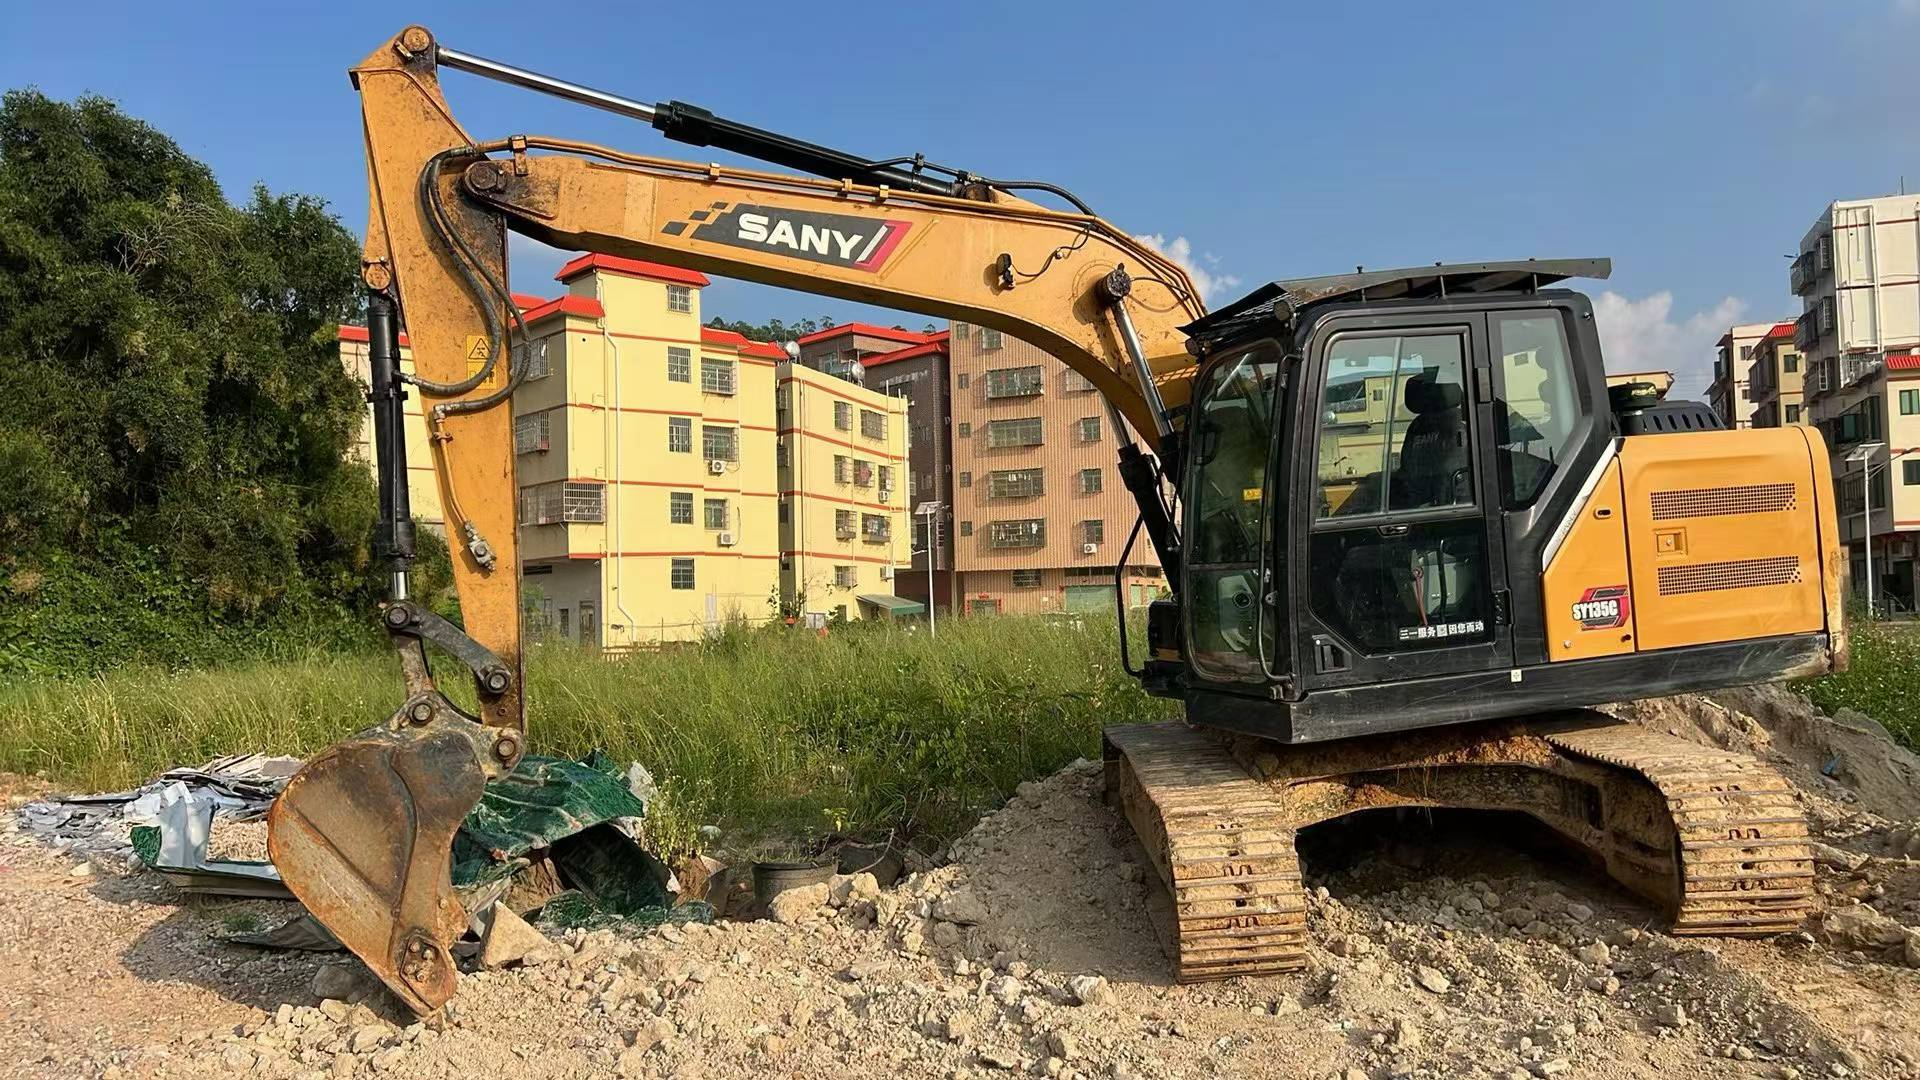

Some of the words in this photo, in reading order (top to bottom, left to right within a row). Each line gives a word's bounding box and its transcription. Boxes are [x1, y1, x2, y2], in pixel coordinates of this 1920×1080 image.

[738, 213, 863, 260] SANY
[1572, 599, 1618, 620] SY135C
[1400, 626, 1436, 640] 三一服务
